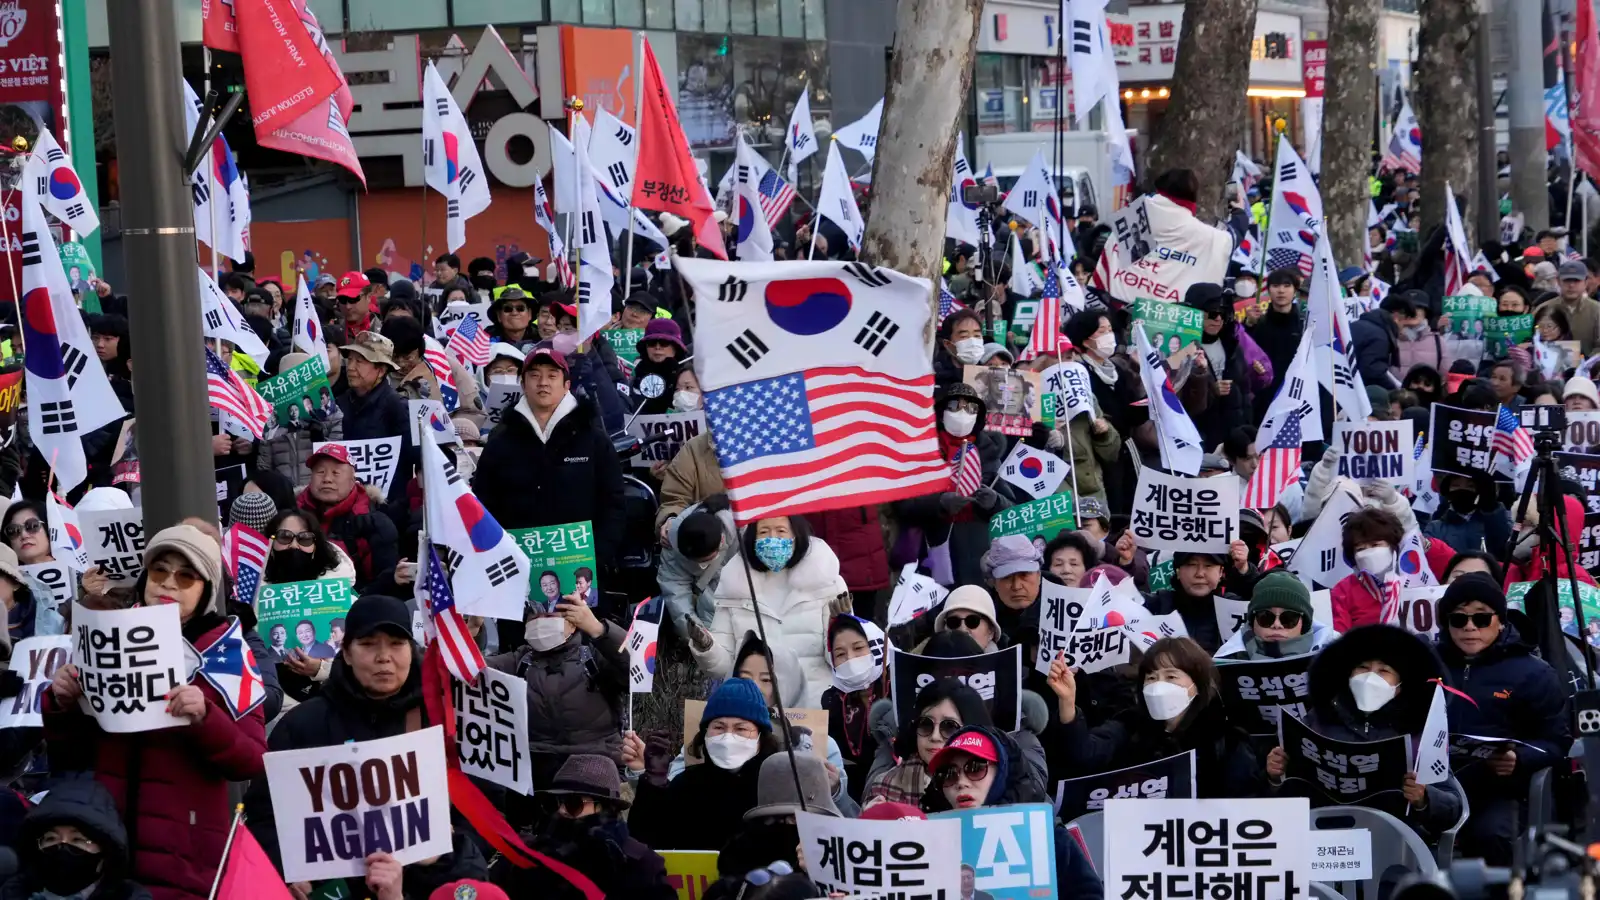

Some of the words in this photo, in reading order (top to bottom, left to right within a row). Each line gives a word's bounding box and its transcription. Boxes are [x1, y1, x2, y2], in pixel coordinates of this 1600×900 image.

[264, 0, 288, 37] UPTION
[284, 39, 307, 68] ARMY
[1155, 247, 1197, 266] gain
[1114, 268, 1180, 302] KOREA
[602, 331, 645, 347] 유한
[260, 357, 323, 398] 자유한길단
[349, 443, 393, 472] 란은
[1341, 430, 1399, 454] YOON
[1456, 446, 1490, 471] 무죄
[1338, 454, 1403, 479] AGAIN
[991, 495, 1070, 532] 자유한길단
[1145, 483, 1221, 515] 계엄은
[1134, 509, 1235, 544] 정당했다
[259, 580, 348, 609] 유한길단
[1398, 598, 1440, 632] YO
[29, 647, 73, 680] YO
[78, 625, 160, 668] 계엄은
[1041, 628, 1128, 667] 정당했다
[77, 667, 180, 714] 당했다
[1237, 671, 1308, 700] 윤석열
[1301, 737, 1380, 774] 윤석열
[298, 750, 420, 813] YOON
[1316, 766, 1367, 794] 무죄
[304, 797, 431, 864] AGAIN
[1142, 818, 1277, 867] 계엄은
[817, 836, 930, 887] 계엄은
[973, 810, 1050, 890] 죄
